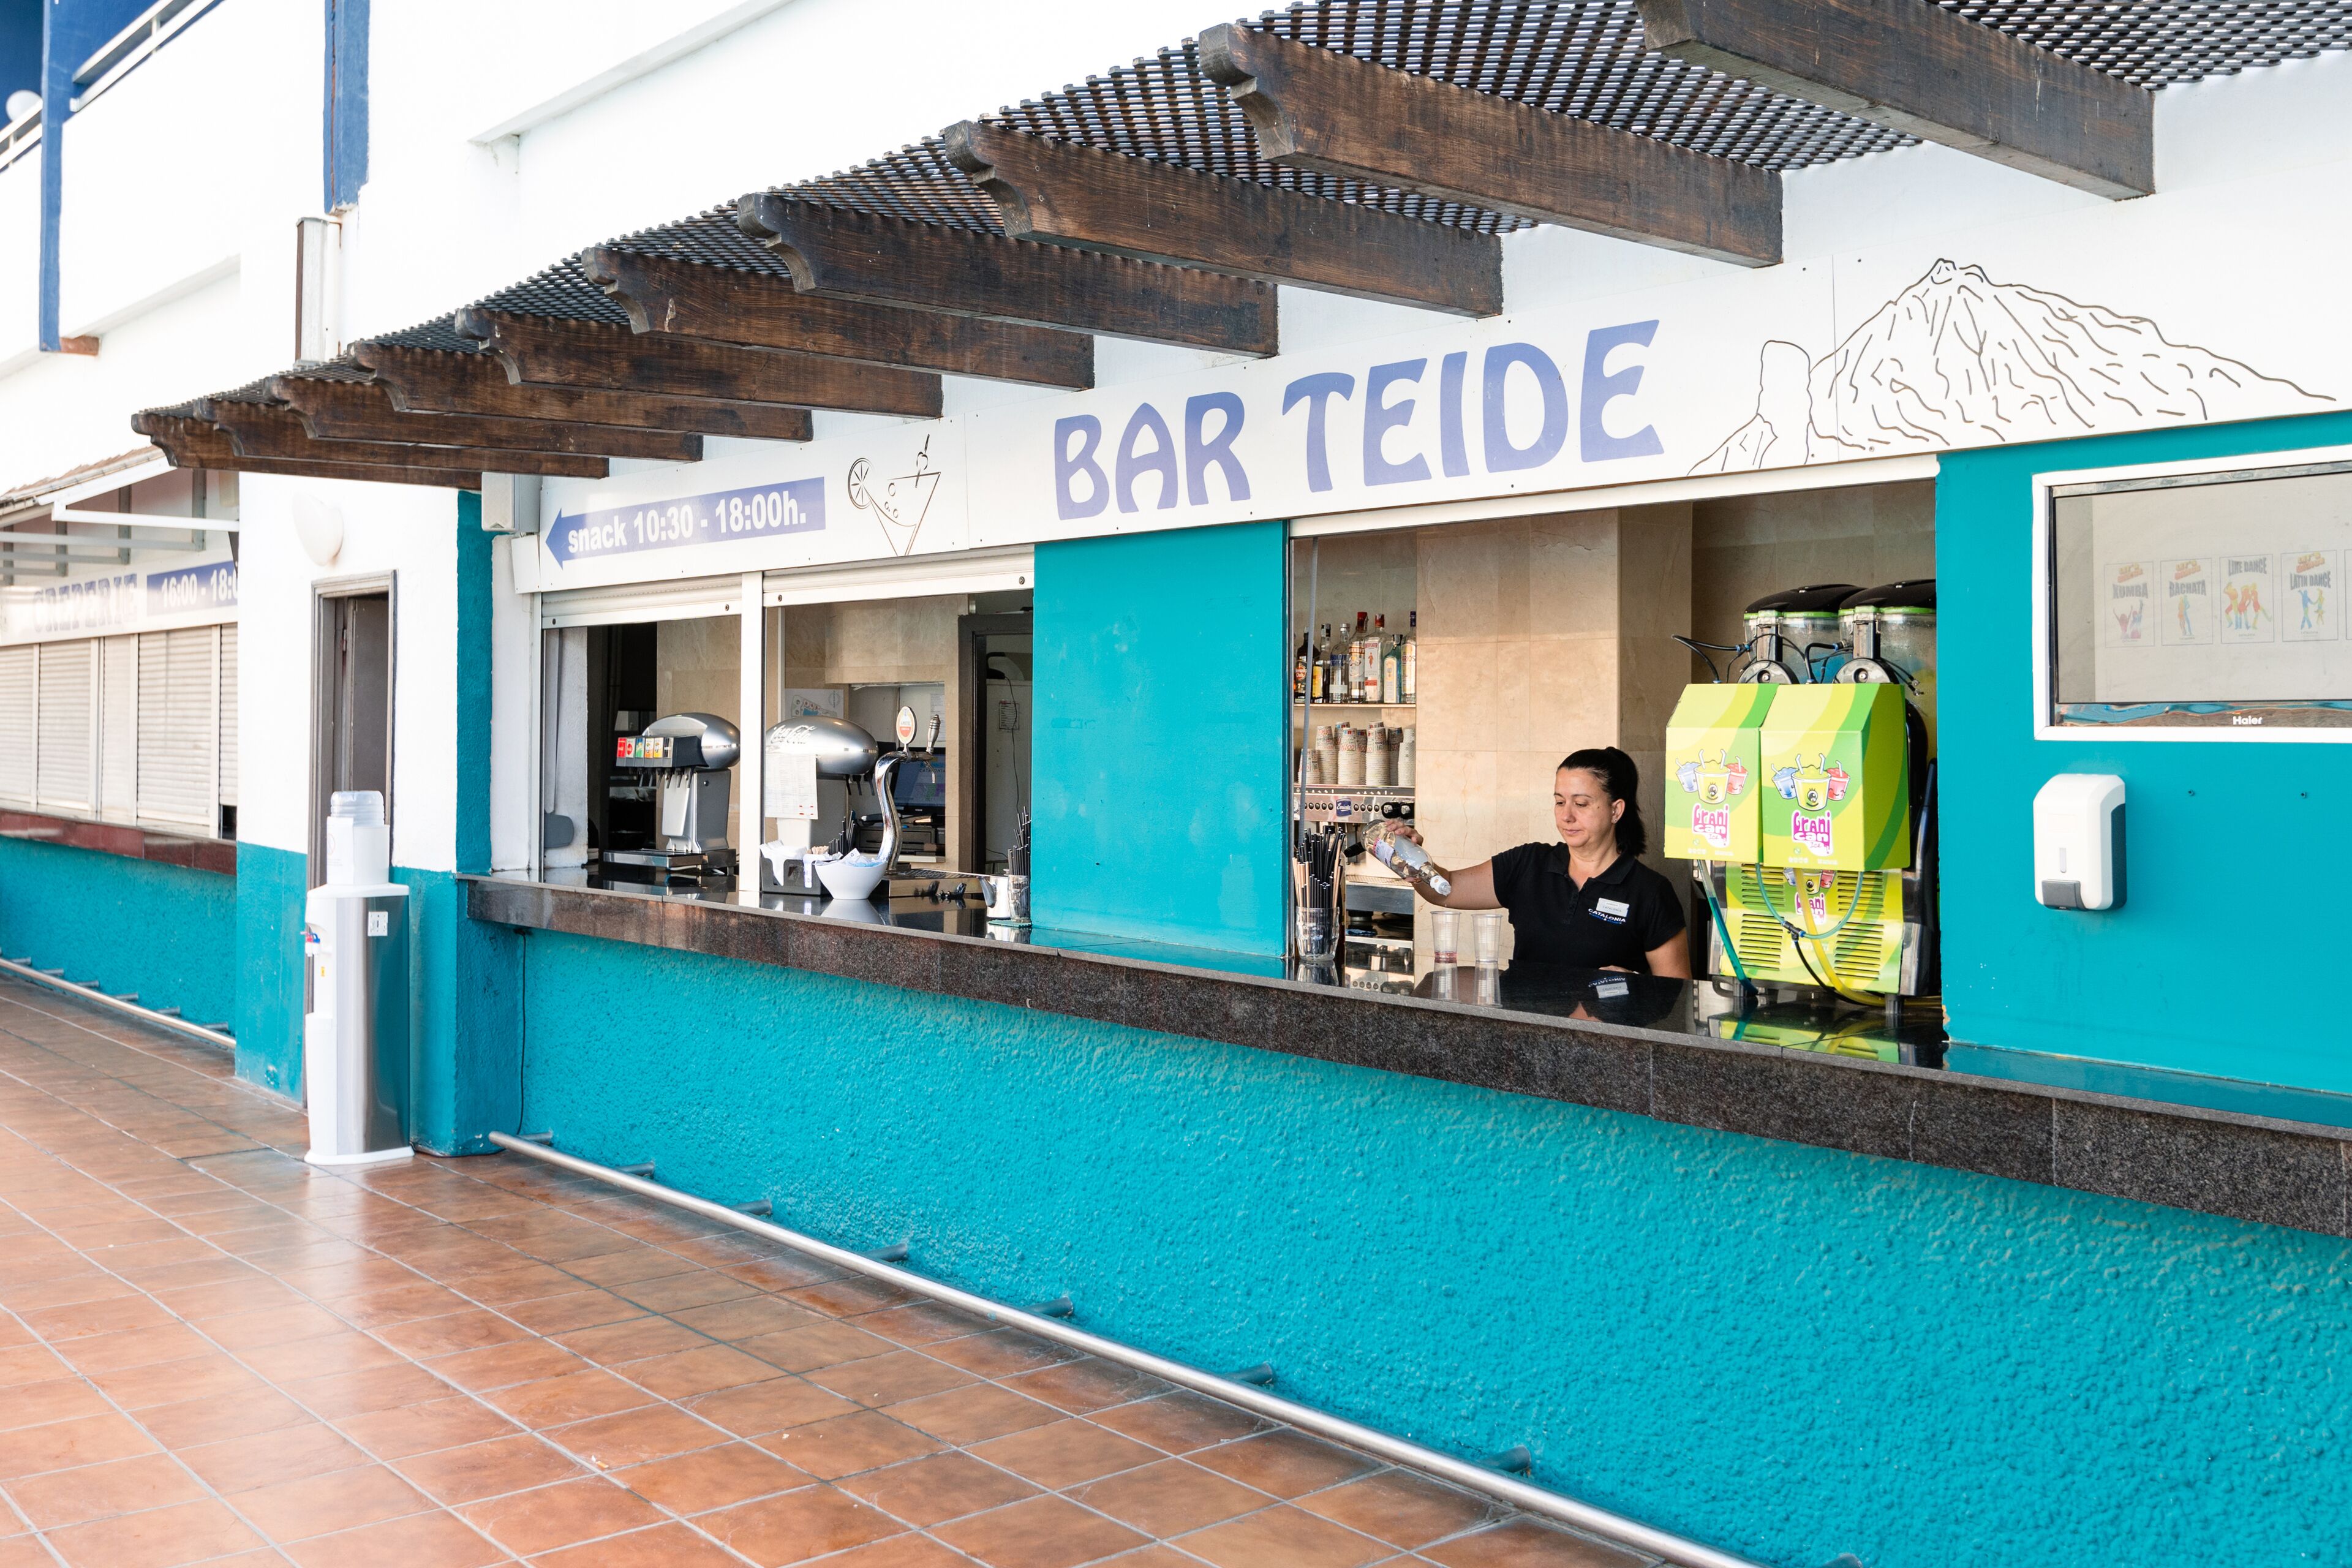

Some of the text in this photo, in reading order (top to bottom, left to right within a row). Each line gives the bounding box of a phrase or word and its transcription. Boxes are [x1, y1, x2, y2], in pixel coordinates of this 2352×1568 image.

[1054, 319, 1665, 521] BAR TEIDE
[568, 515, 627, 552] snack
[633, 505, 693, 544] 10:30
[715, 491, 806, 533] 18:00h.
[2244, 557, 2267, 574] DANCE
[2169, 579, 2206, 598] BACHATA
[2290, 570, 2331, 590] LATIN DANCE
[160, 573, 197, 608] 16:00
[2233, 715, 2263, 725] Haier
[1694, 804, 1728, 825] Grani
[1793, 812, 1830, 832] Grani
[1694, 824, 1727, 834] can
[1793, 831, 1829, 842] can
[1588, 908, 1626, 922] CATALONIA
